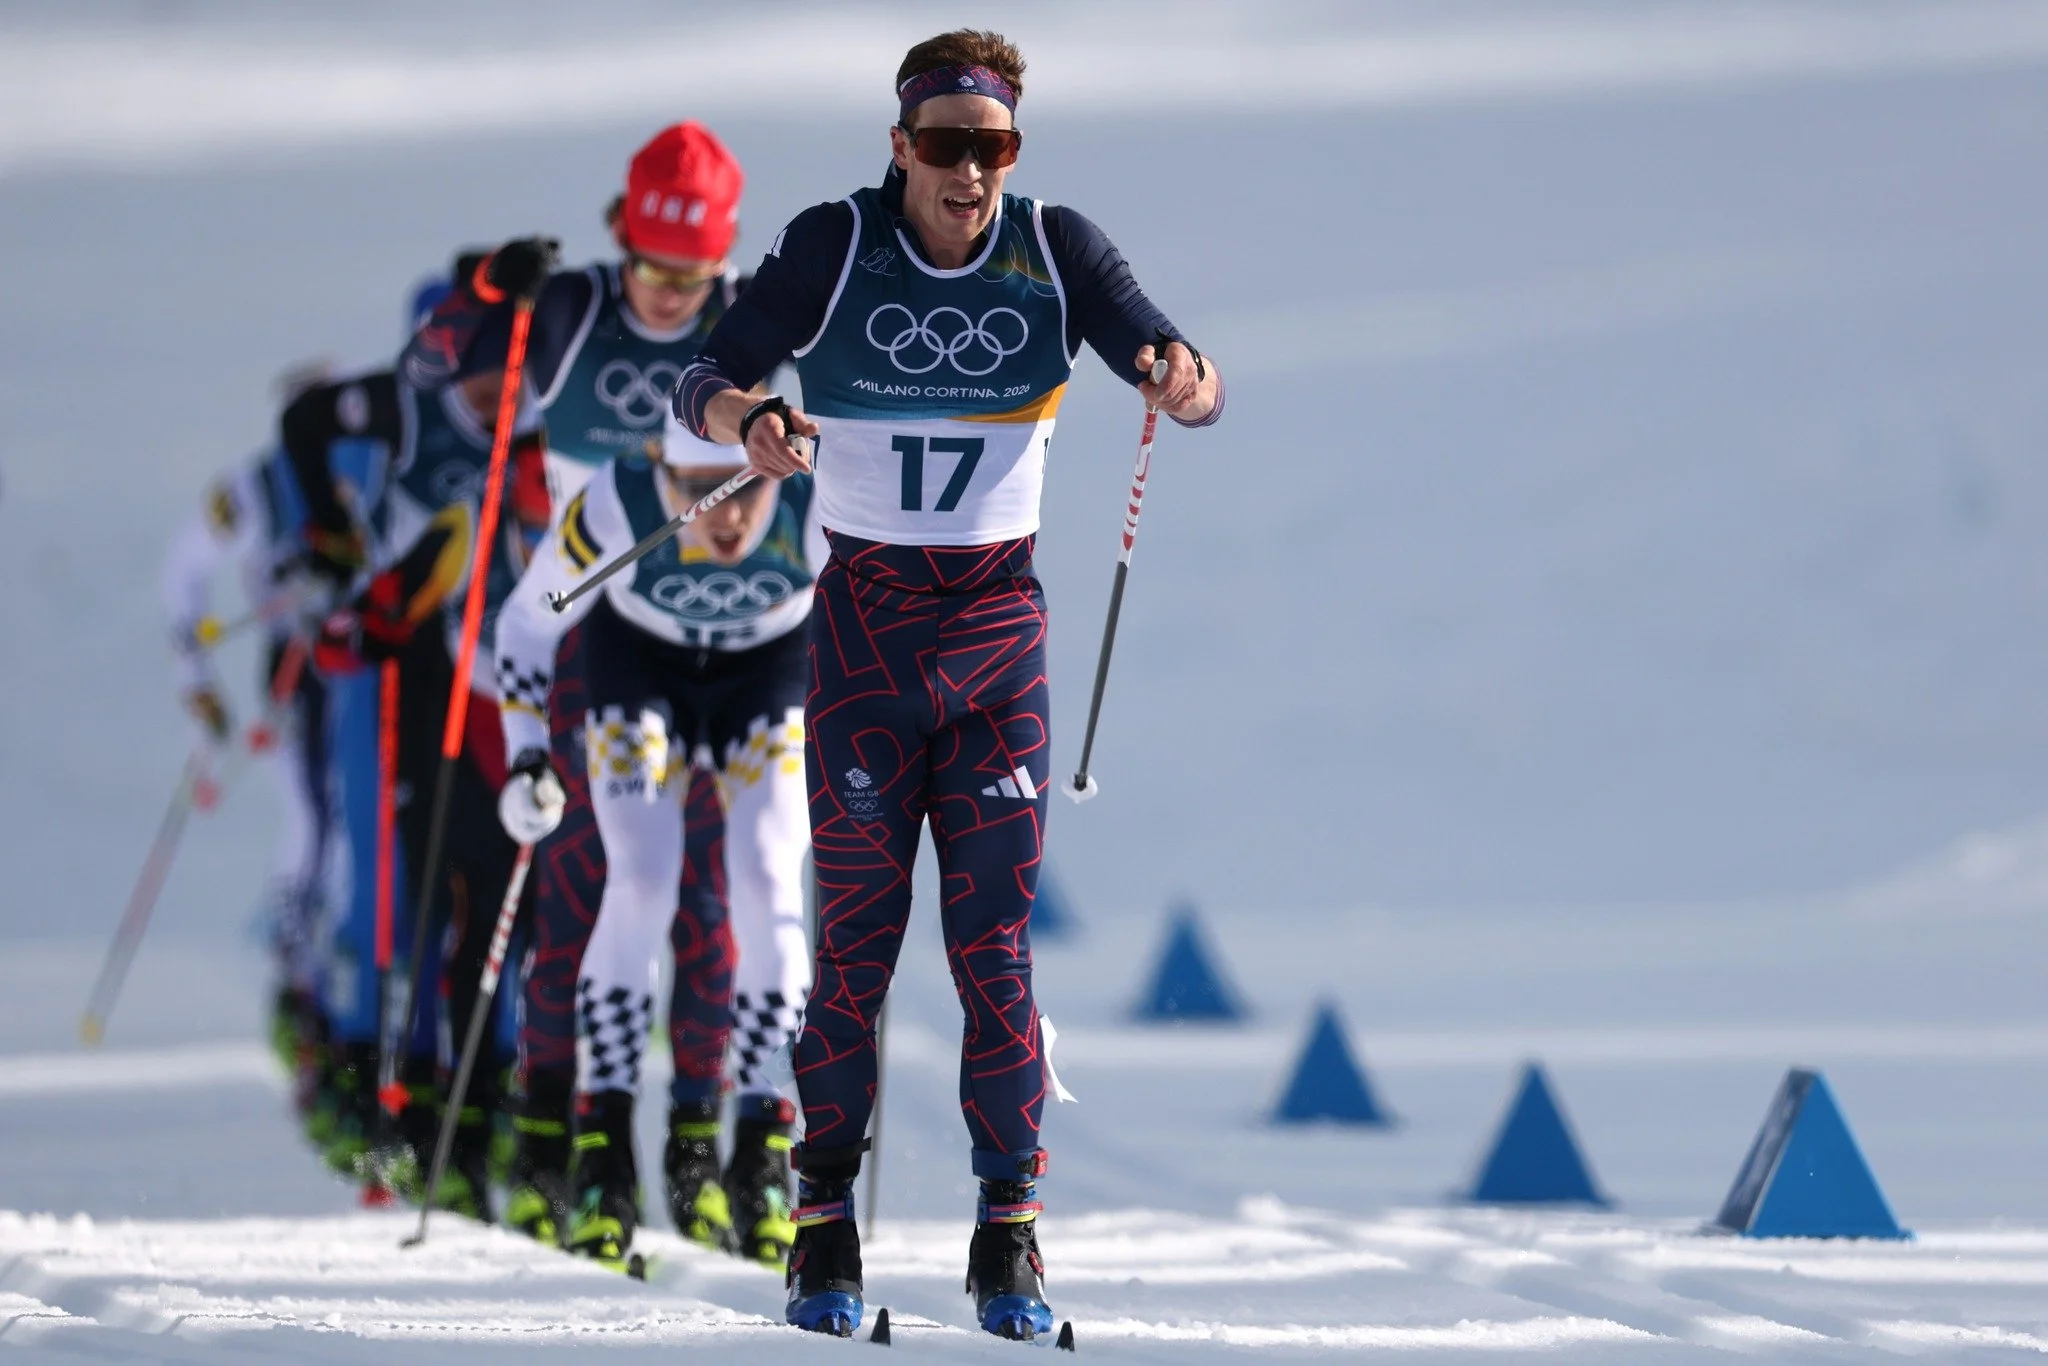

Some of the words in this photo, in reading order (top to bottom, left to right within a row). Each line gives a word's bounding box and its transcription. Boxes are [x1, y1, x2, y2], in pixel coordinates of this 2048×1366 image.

[852, 379, 921, 397] MILANO
[924, 386, 999, 398] CORTINA
[1003, 383, 1031, 398] 2026
[891, 434, 985, 512] 17
